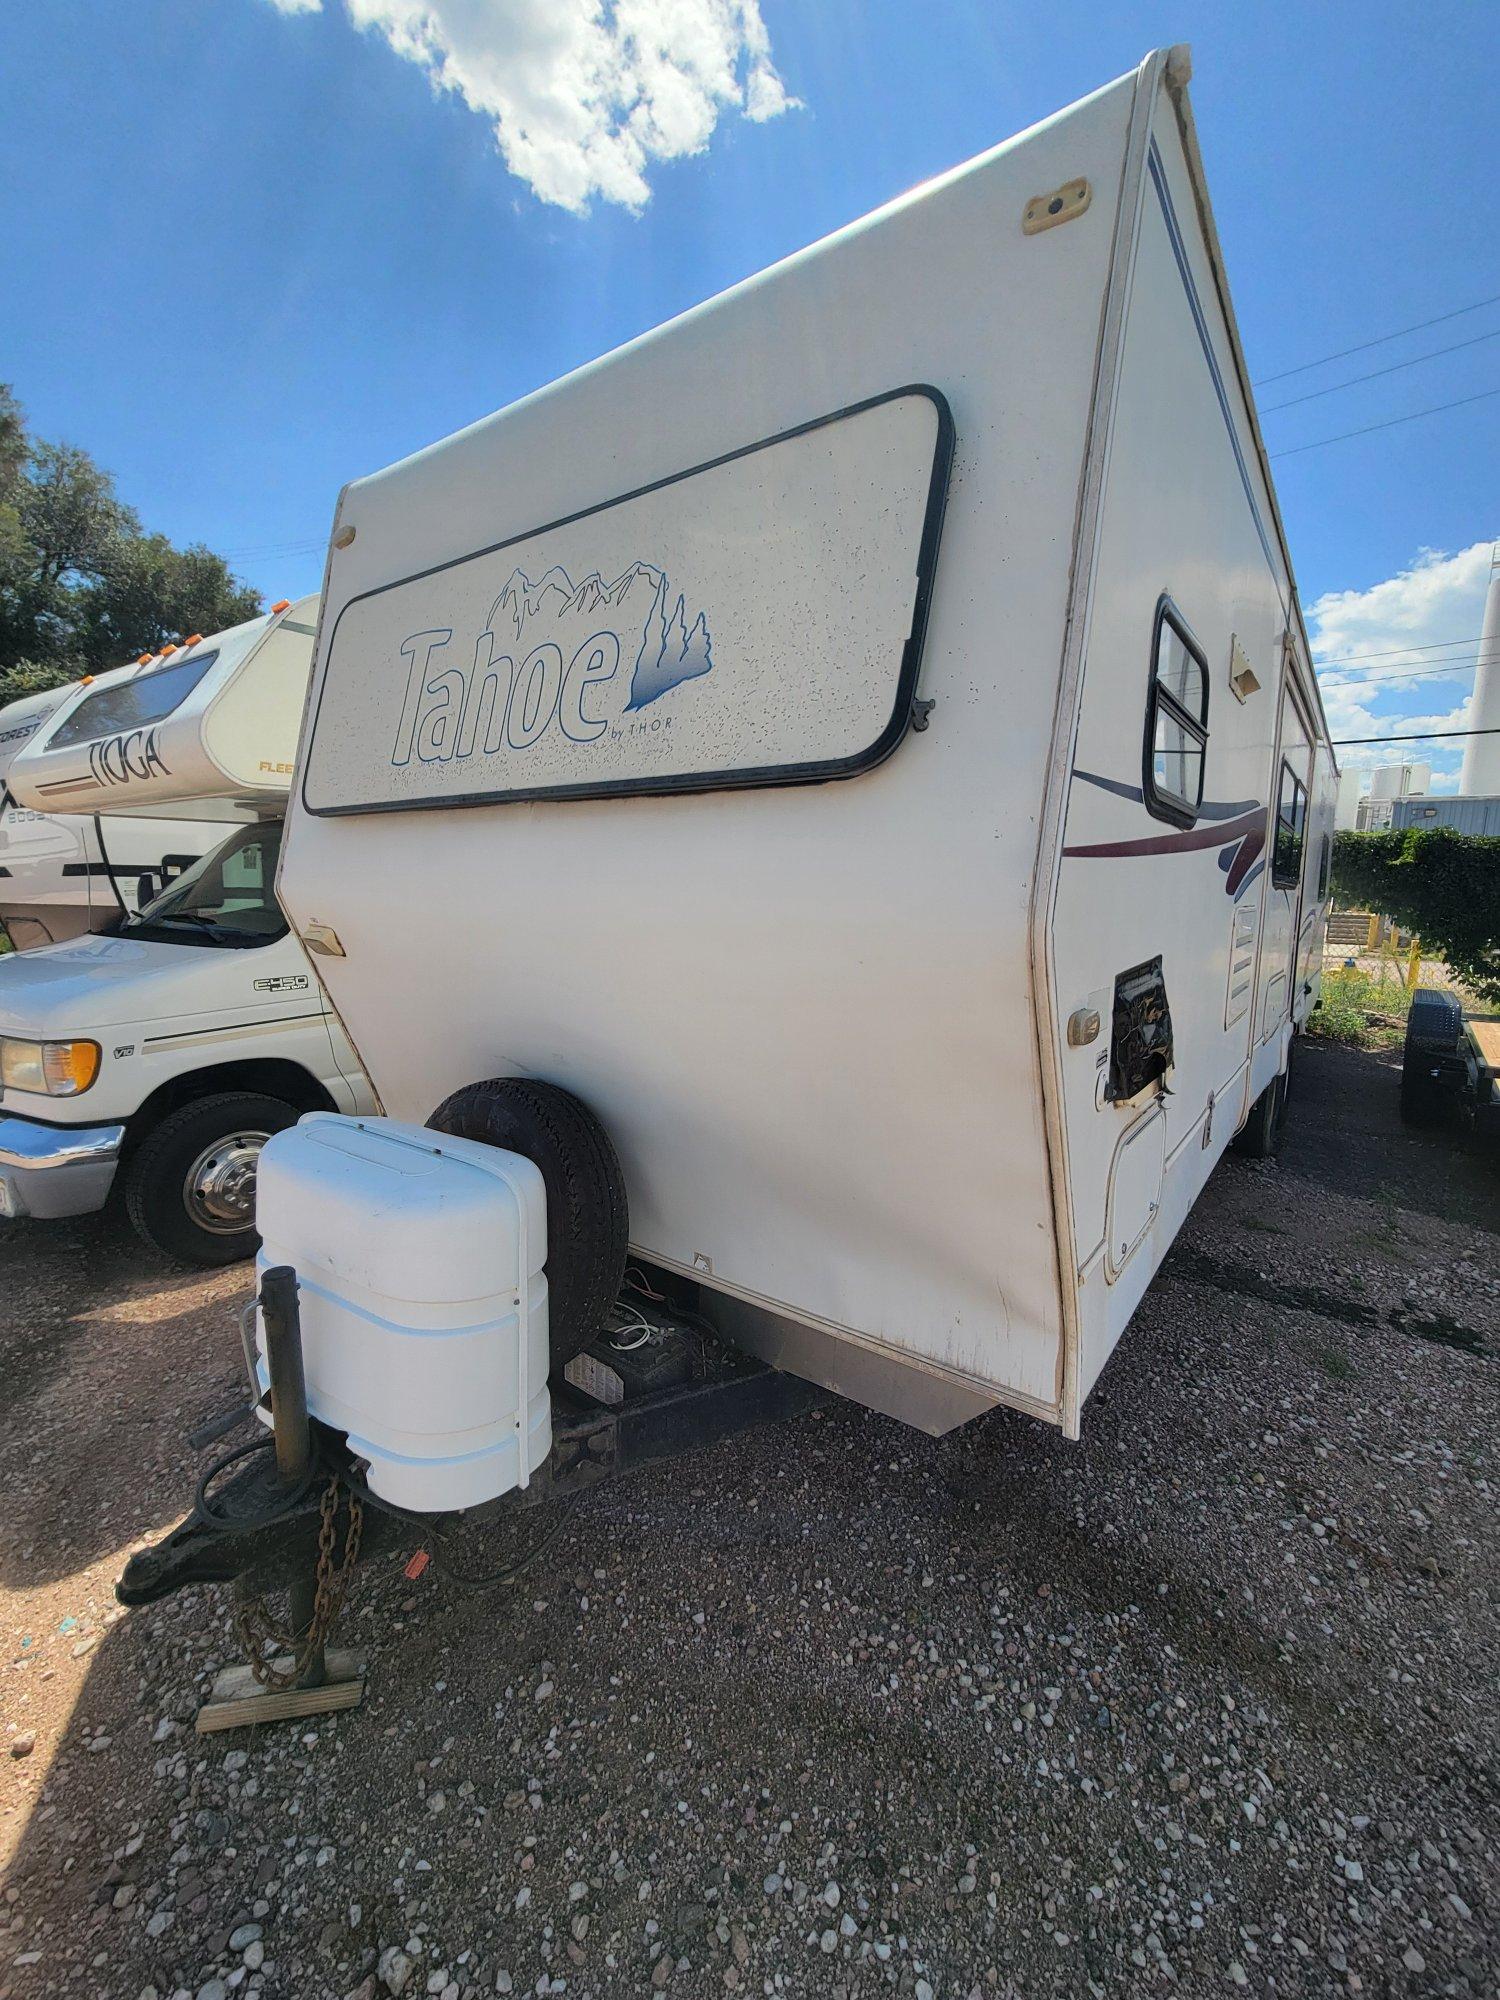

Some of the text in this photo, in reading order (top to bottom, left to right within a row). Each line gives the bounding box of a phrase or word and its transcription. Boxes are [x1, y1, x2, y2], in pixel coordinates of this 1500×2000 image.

[391, 628, 620, 767] Tahoe
[0, 722, 41, 742] OREST
[611, 717, 672, 741] by THOR
[88, 727, 173, 787] TIOGA
